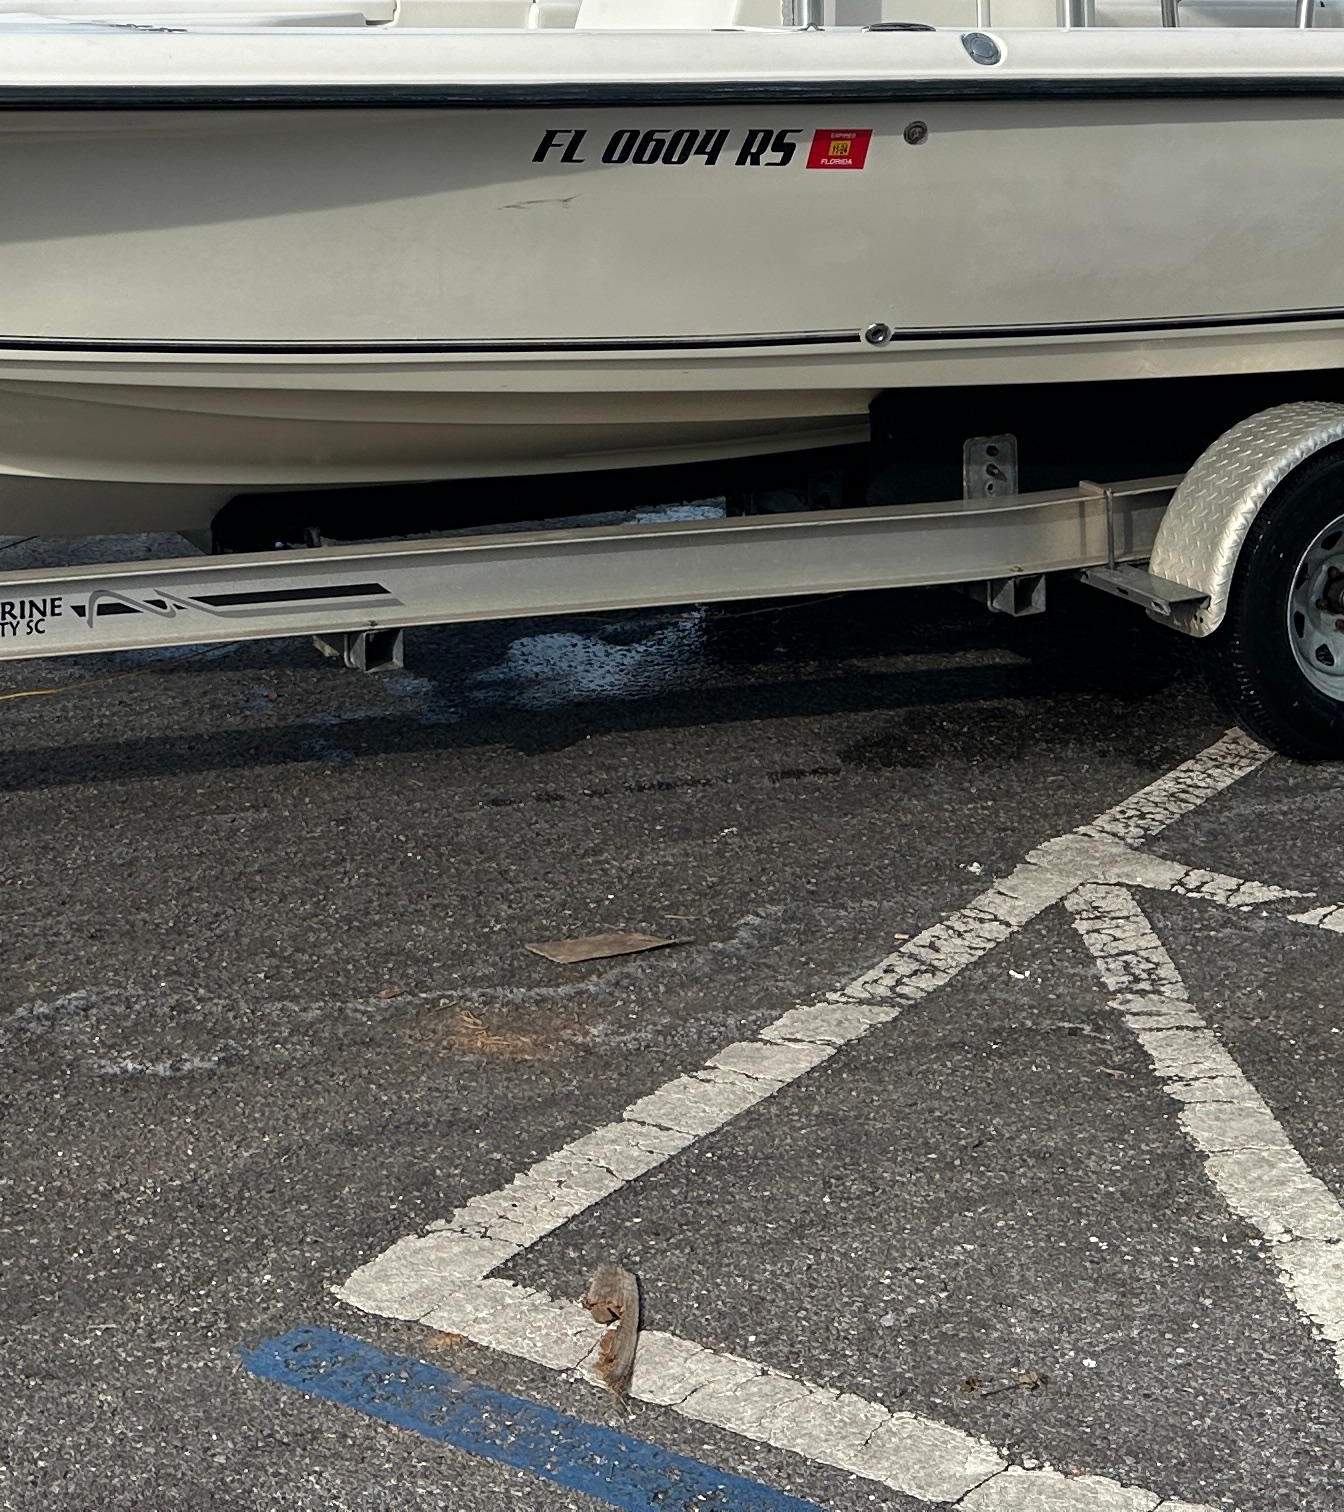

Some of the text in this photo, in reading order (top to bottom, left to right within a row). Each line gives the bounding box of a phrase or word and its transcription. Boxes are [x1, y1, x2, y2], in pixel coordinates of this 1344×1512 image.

[532, 129, 804, 166] FL 0604 RS
[26, 618, 47, 635] SC
